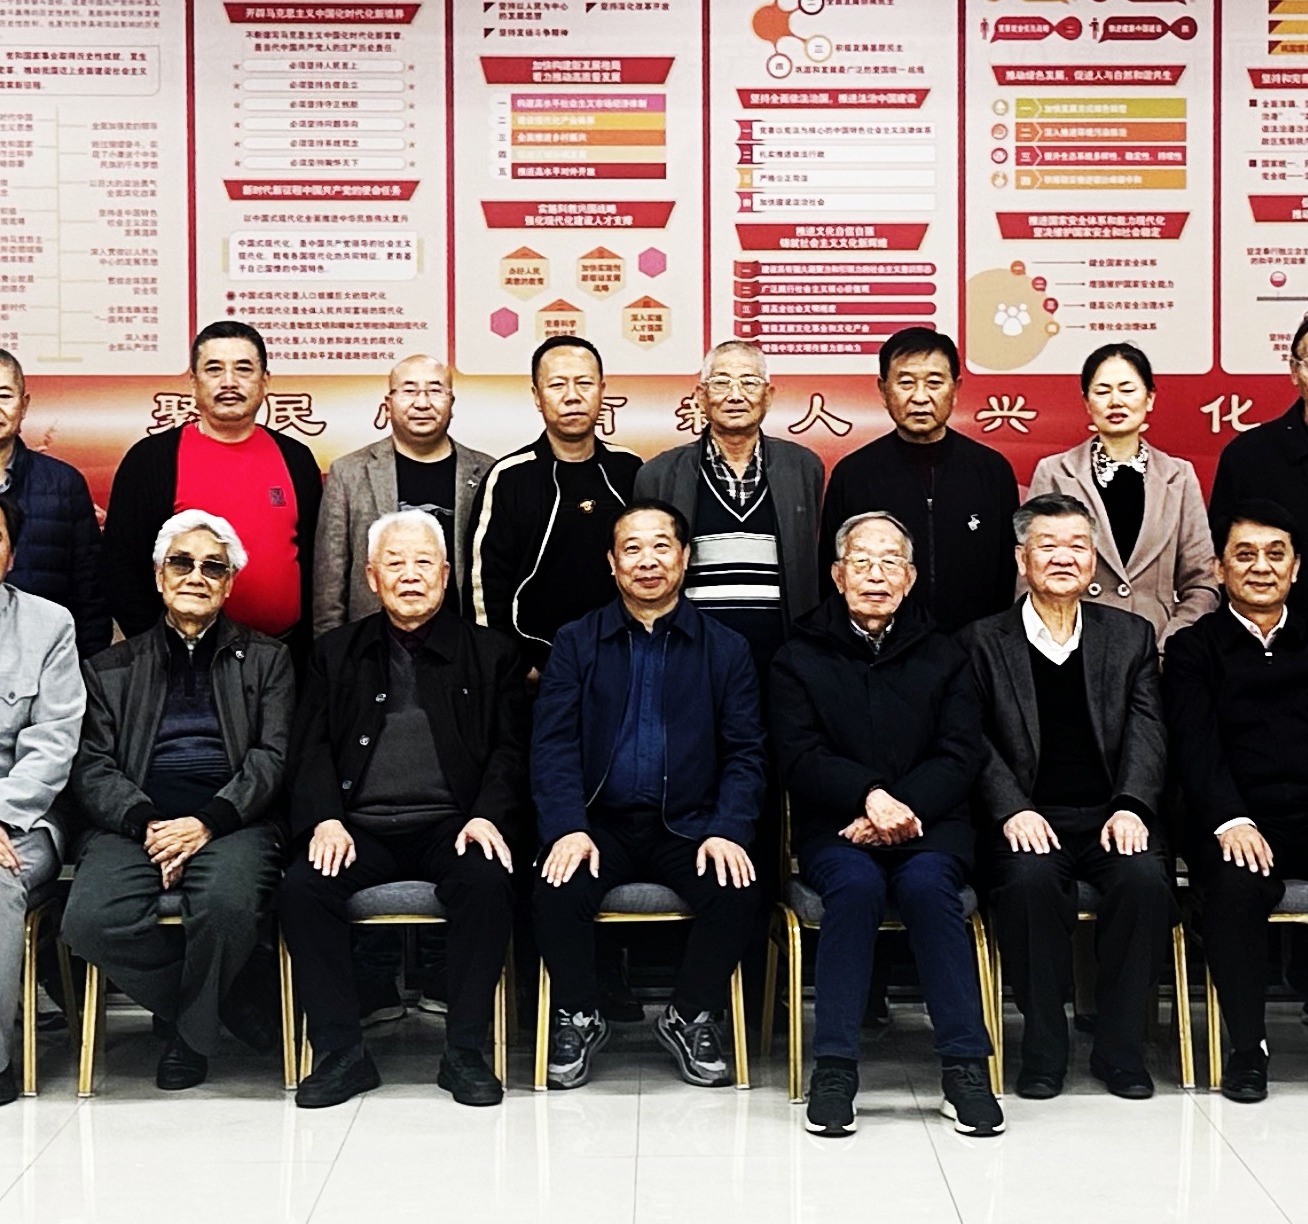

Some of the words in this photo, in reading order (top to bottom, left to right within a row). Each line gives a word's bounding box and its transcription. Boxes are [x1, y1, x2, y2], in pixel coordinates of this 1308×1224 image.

[264, 393, 326, 436] 民
[788, 393, 852, 437] 人
[974, 395, 1038, 433] 兴
[1200, 394, 1262, 433] 化
